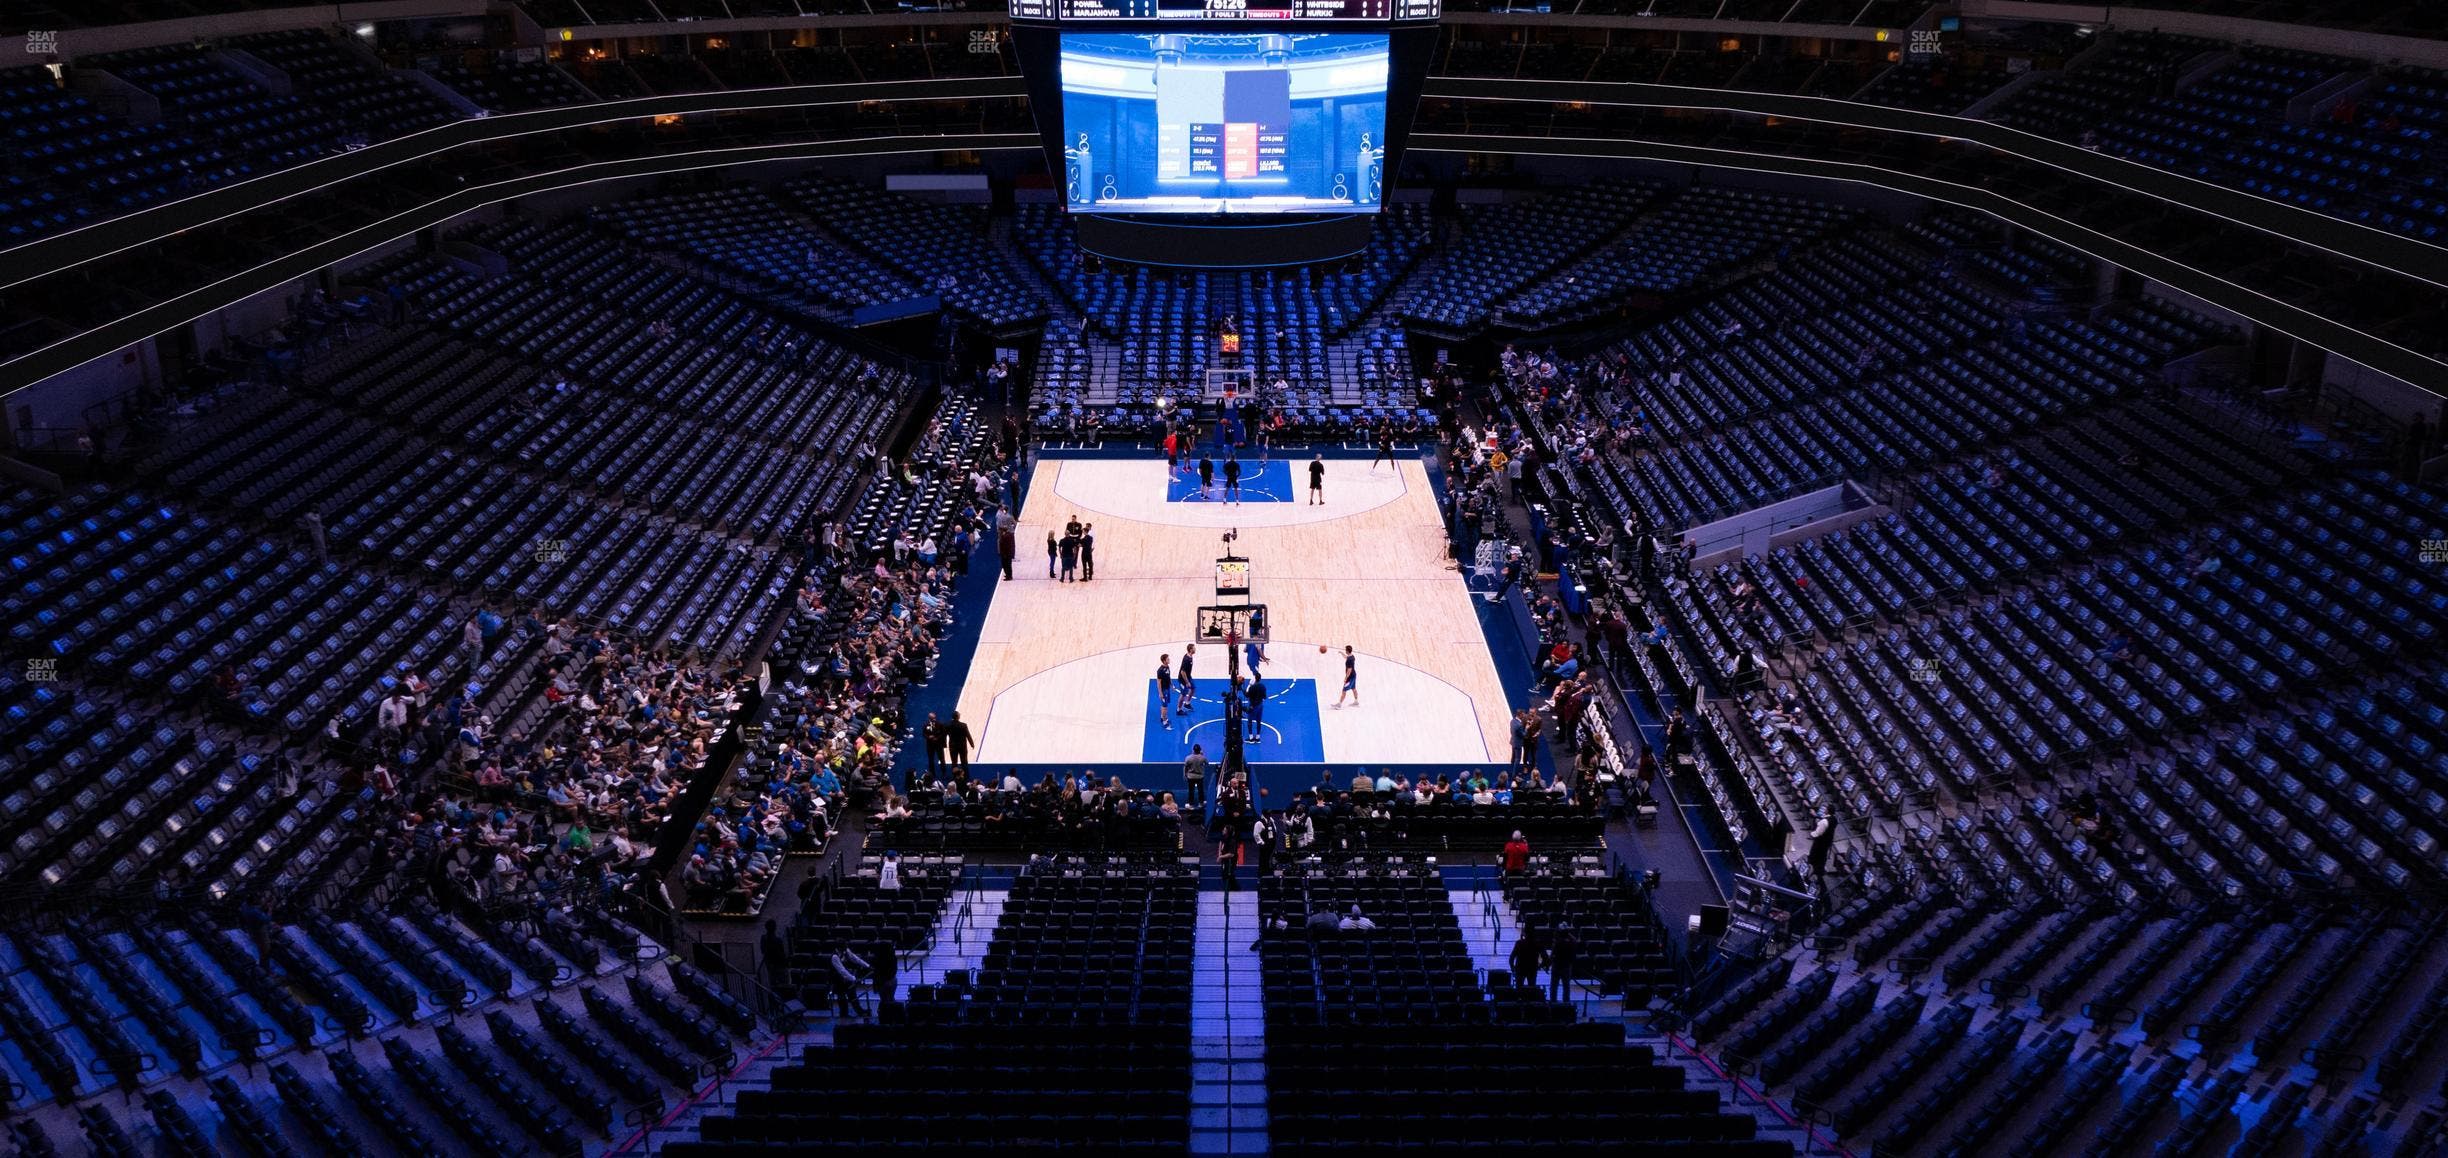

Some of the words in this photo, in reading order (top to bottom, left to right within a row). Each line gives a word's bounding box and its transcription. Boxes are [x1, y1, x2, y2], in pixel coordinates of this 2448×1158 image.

[1204, 0, 1246, 10] 75:26
[1013, 7, 1018, 15] 0
[1046, 8, 1051, 17] 0
[1399, 9, 1404, 17] 0
[1432, 8, 1437, 16] 0
[1224, 341, 1237, 352] 24
